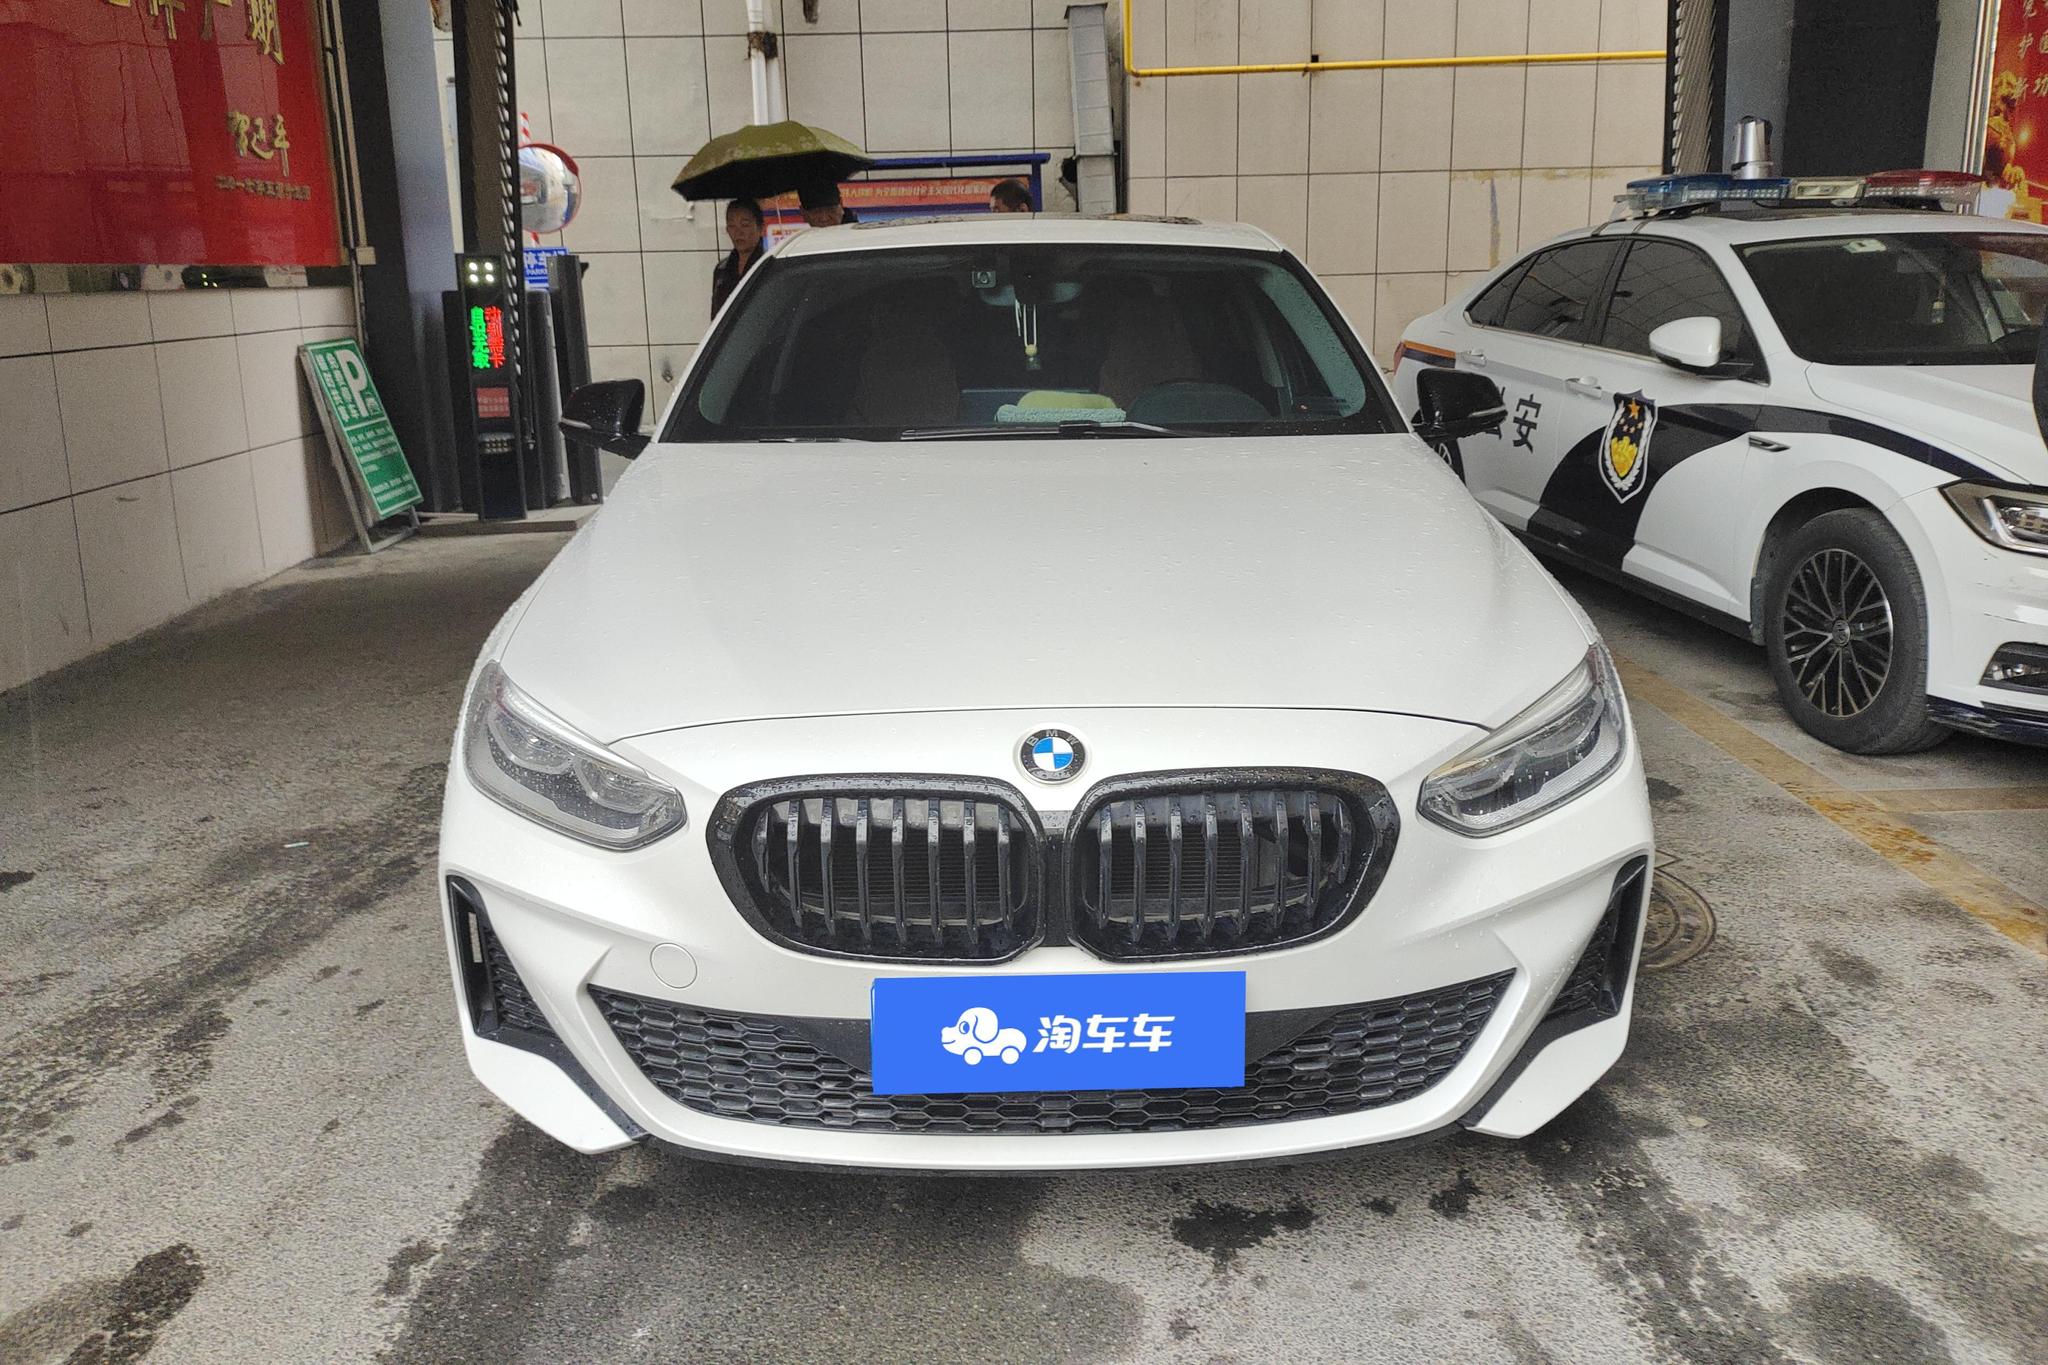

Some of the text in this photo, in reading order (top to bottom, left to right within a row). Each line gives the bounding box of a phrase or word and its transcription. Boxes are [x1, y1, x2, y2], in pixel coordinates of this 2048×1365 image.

[334, 349, 368, 417] P
[1495, 387, 1542, 453] 安
[1027, 729, 1077, 746] BMW
